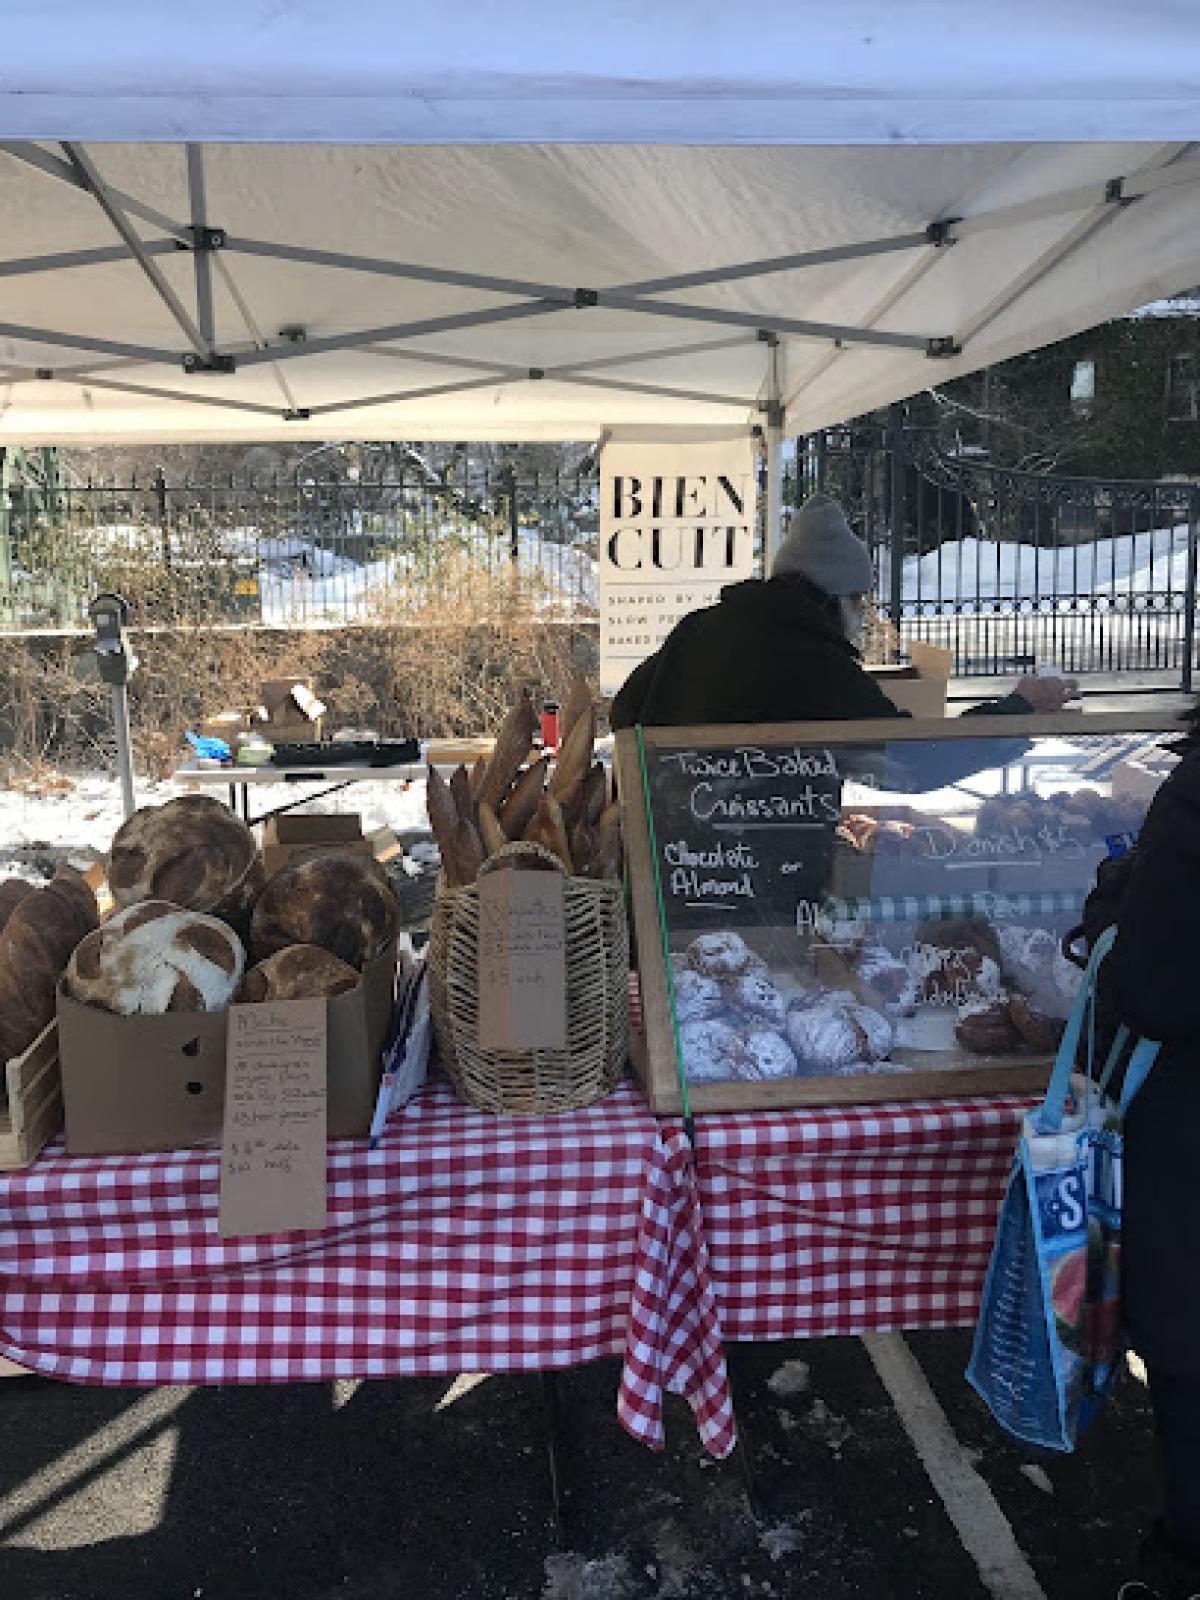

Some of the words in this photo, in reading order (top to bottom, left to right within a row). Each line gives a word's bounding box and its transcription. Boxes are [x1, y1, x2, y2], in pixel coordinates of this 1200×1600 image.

[608, 475, 750, 518] BIEN
[606, 525, 750, 570] CUIT
[670, 867, 756, 898] Almond
